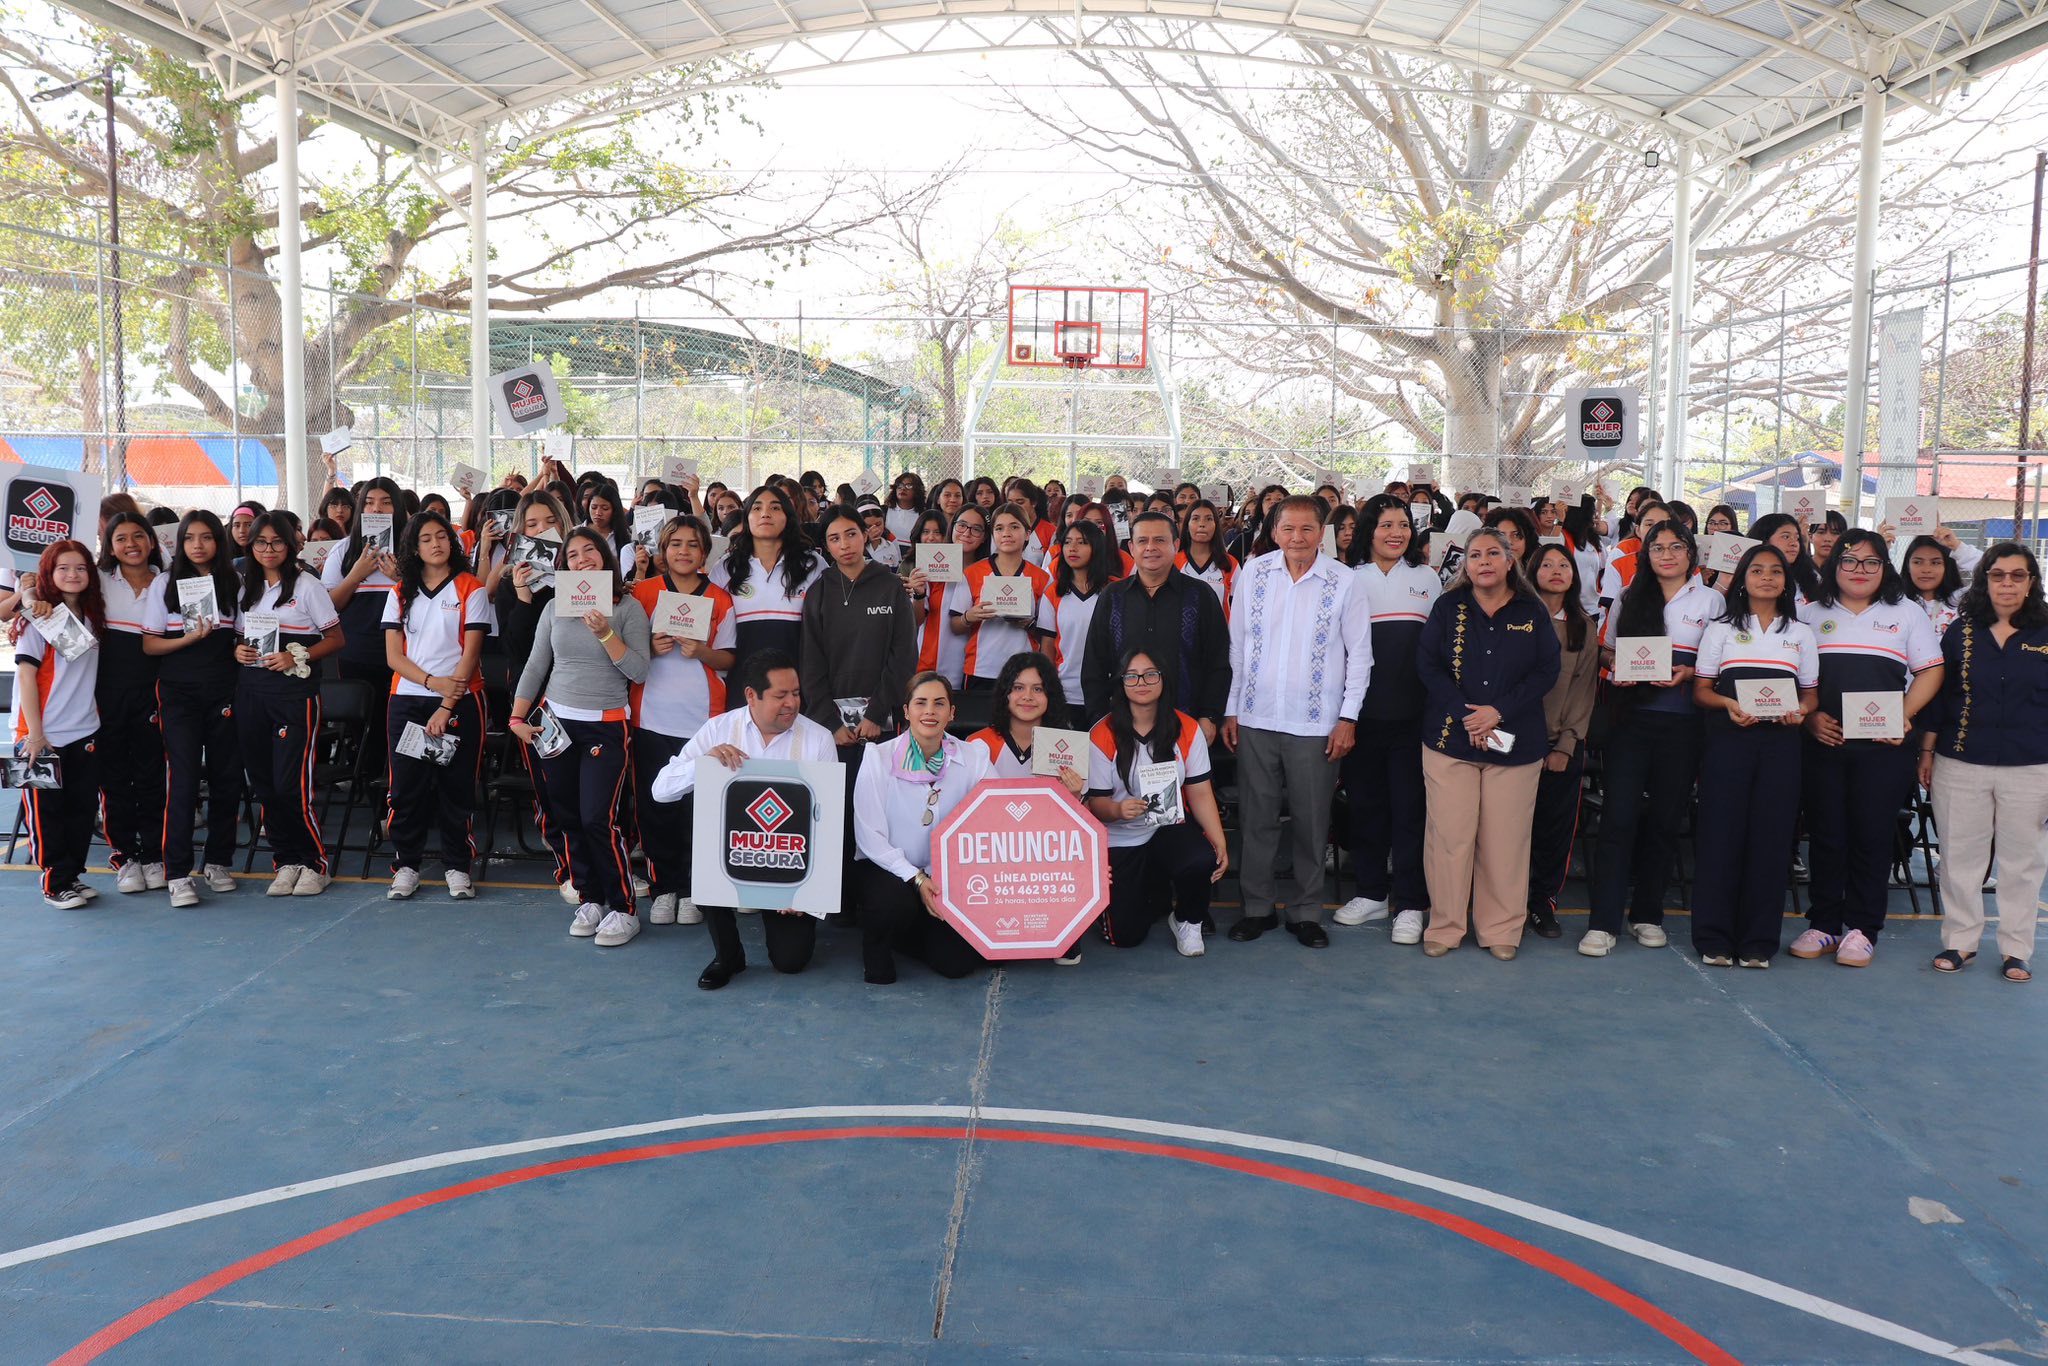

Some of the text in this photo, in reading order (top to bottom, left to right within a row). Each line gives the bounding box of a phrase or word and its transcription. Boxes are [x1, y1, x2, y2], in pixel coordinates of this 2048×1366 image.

[511, 395, 543, 411] MUJER
[513, 403, 547, 418] SEGURA
[1584, 423, 1621, 431] MUJER
[1584, 431, 1621, 440] SEGURA
[10, 515, 69, 535] MUJER
[867, 606, 893, 615] NASA
[670, 615, 695, 624] MUJER
[1048, 753, 1074, 761] MUJER
[731, 832, 805, 851] MUJER
[958, 830, 1085, 864] DENUNCIA
[730, 852, 804, 869] SEGURA
[994, 871, 1075, 883] LÍNEA DIGITAL
[995, 884, 1076, 895] 961 462 93 40
[1005, 897, 1027, 905] horas,
